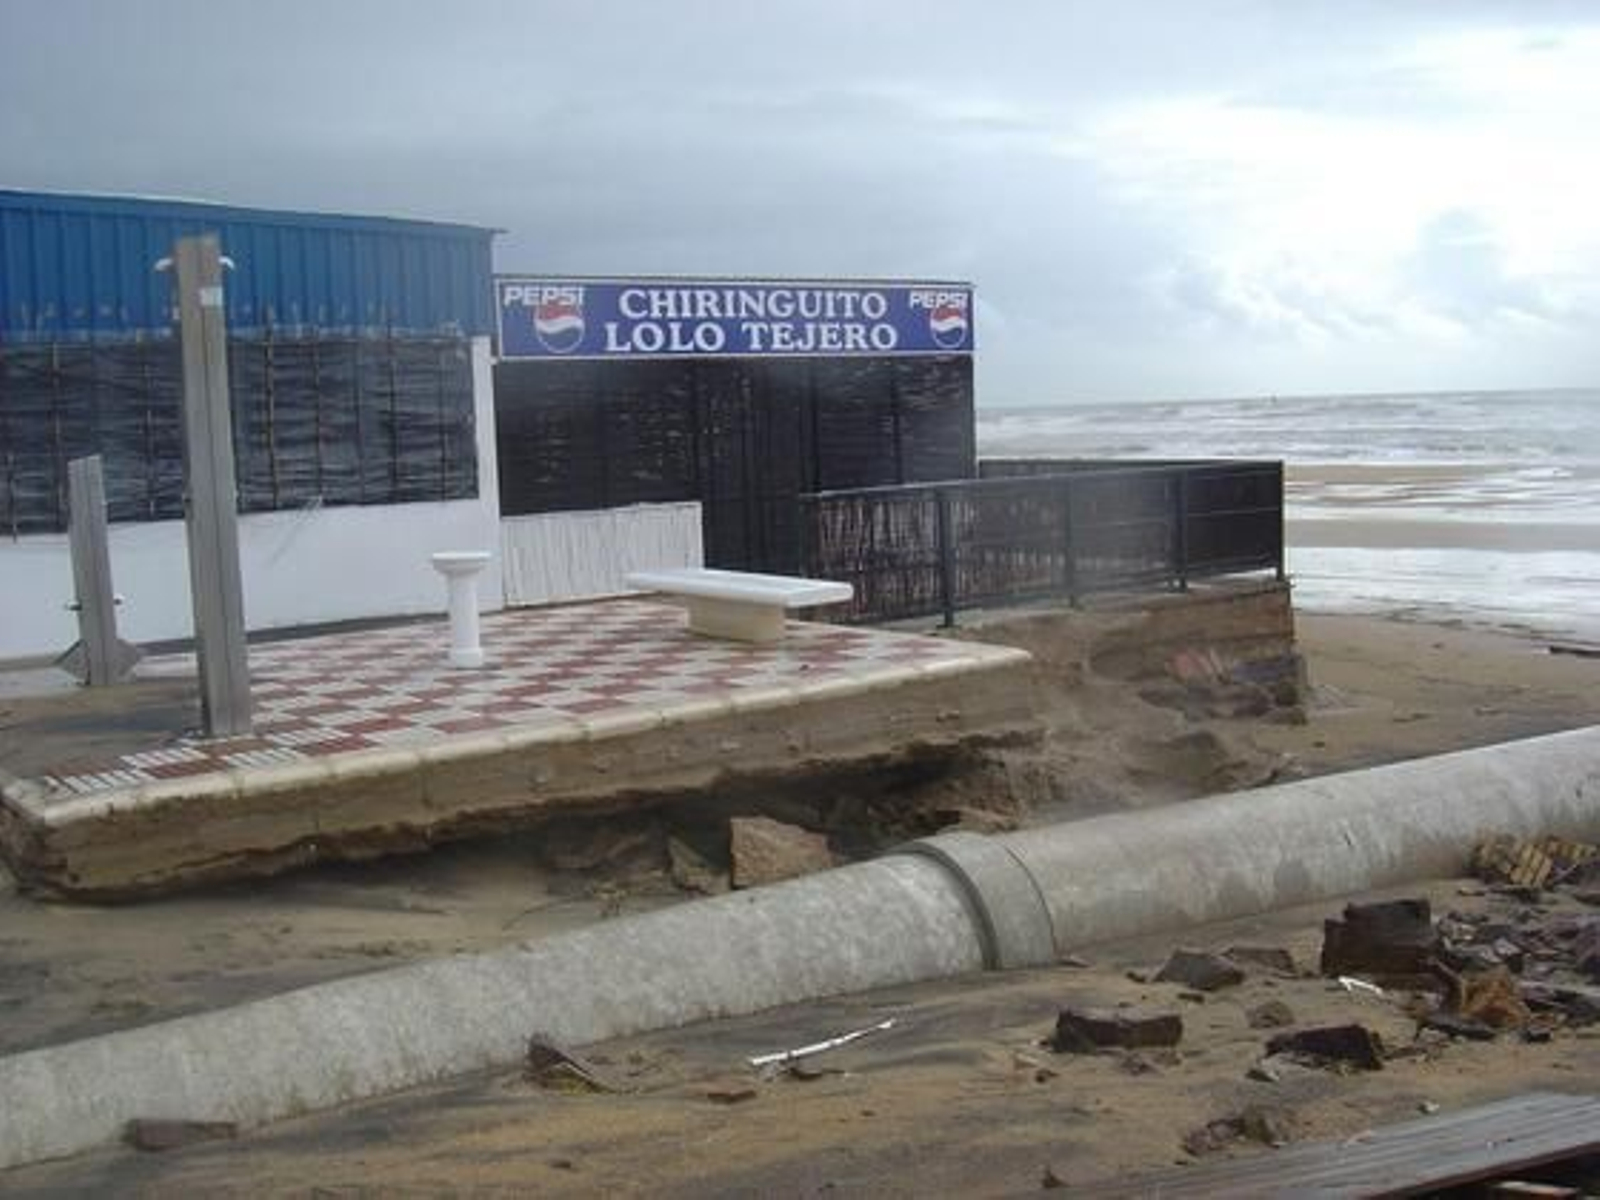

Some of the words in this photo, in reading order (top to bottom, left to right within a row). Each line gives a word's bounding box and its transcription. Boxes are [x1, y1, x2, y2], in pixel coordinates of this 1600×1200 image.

[504, 286, 585, 306] PEPSI
[619, 288, 888, 319] CHIRINGUITO
[909, 290, 968, 309] PEPSI
[605, 322, 726, 351] LOLO
[741, 322, 898, 351] TEJERO
